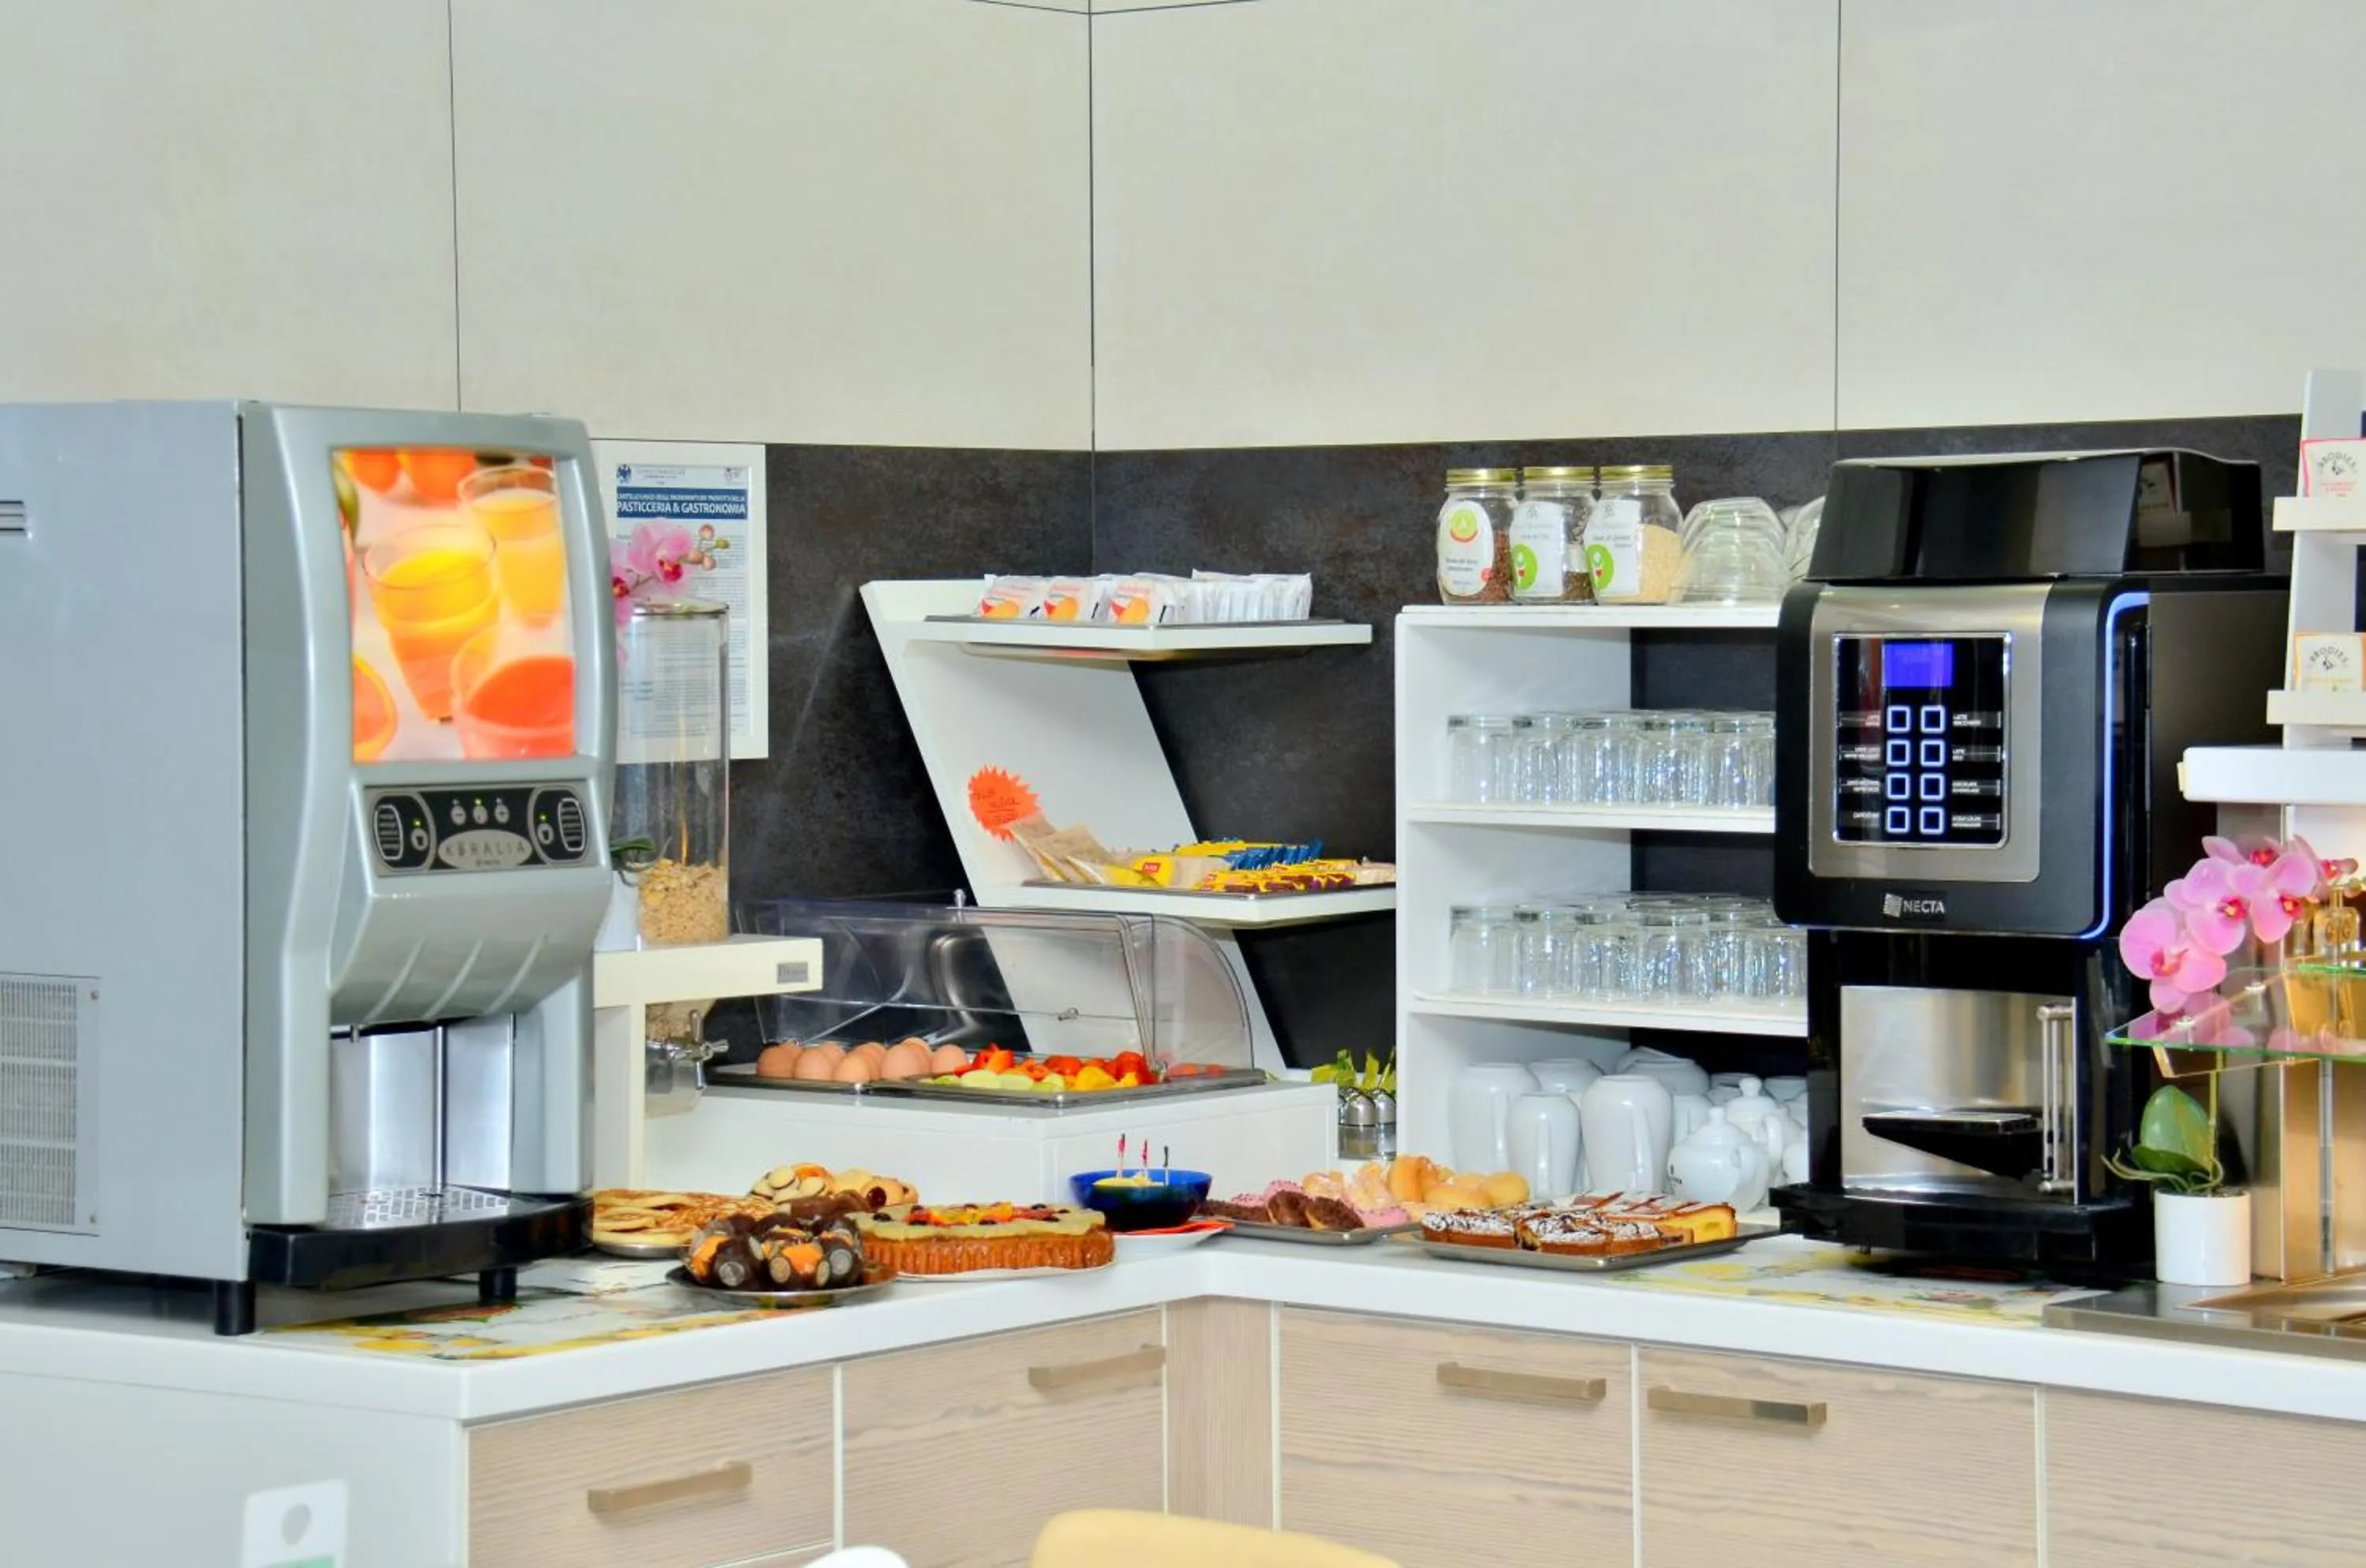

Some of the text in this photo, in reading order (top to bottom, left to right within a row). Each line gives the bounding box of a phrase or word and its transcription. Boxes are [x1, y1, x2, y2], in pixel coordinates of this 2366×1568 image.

[674, 502, 681, 513] &
[681, 502, 745, 513] GASTRONOMIA
[1903, 899, 1946, 913] NECTA
